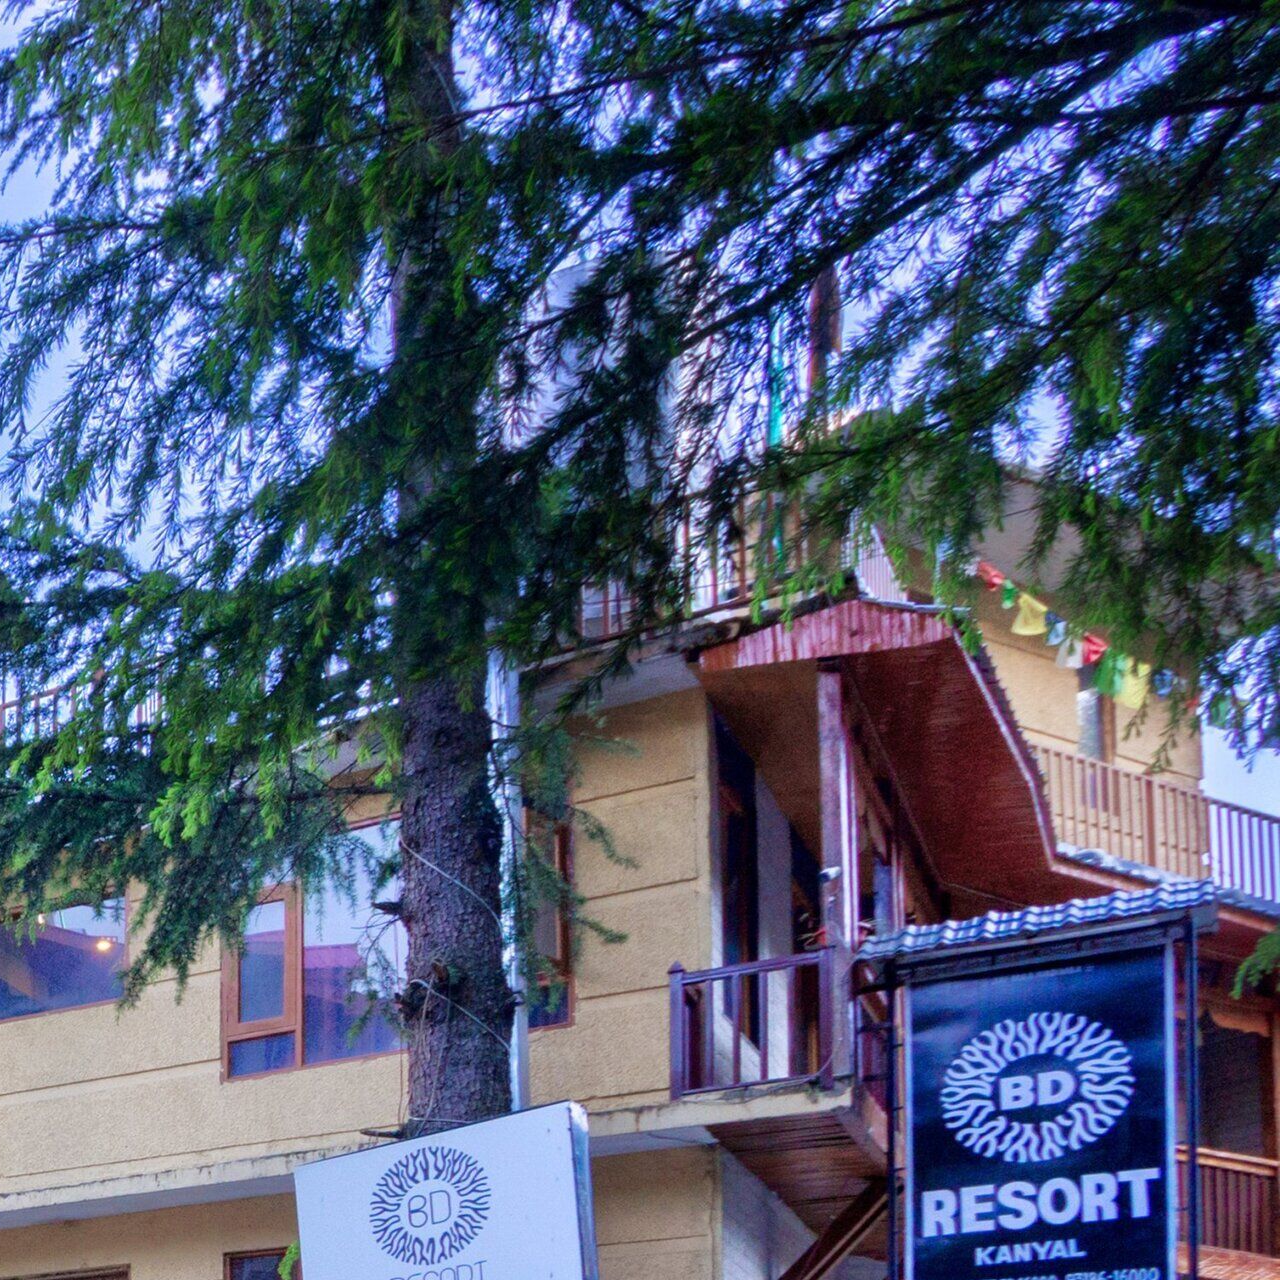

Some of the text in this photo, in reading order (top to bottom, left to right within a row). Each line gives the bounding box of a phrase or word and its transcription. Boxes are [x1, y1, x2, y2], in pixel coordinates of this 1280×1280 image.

[998, 1071, 1076, 1111] BD
[407, 1189, 451, 1228] BD
[921, 1168, 1161, 1239] RESORT
[974, 1239, 1087, 1267] KANYAL
